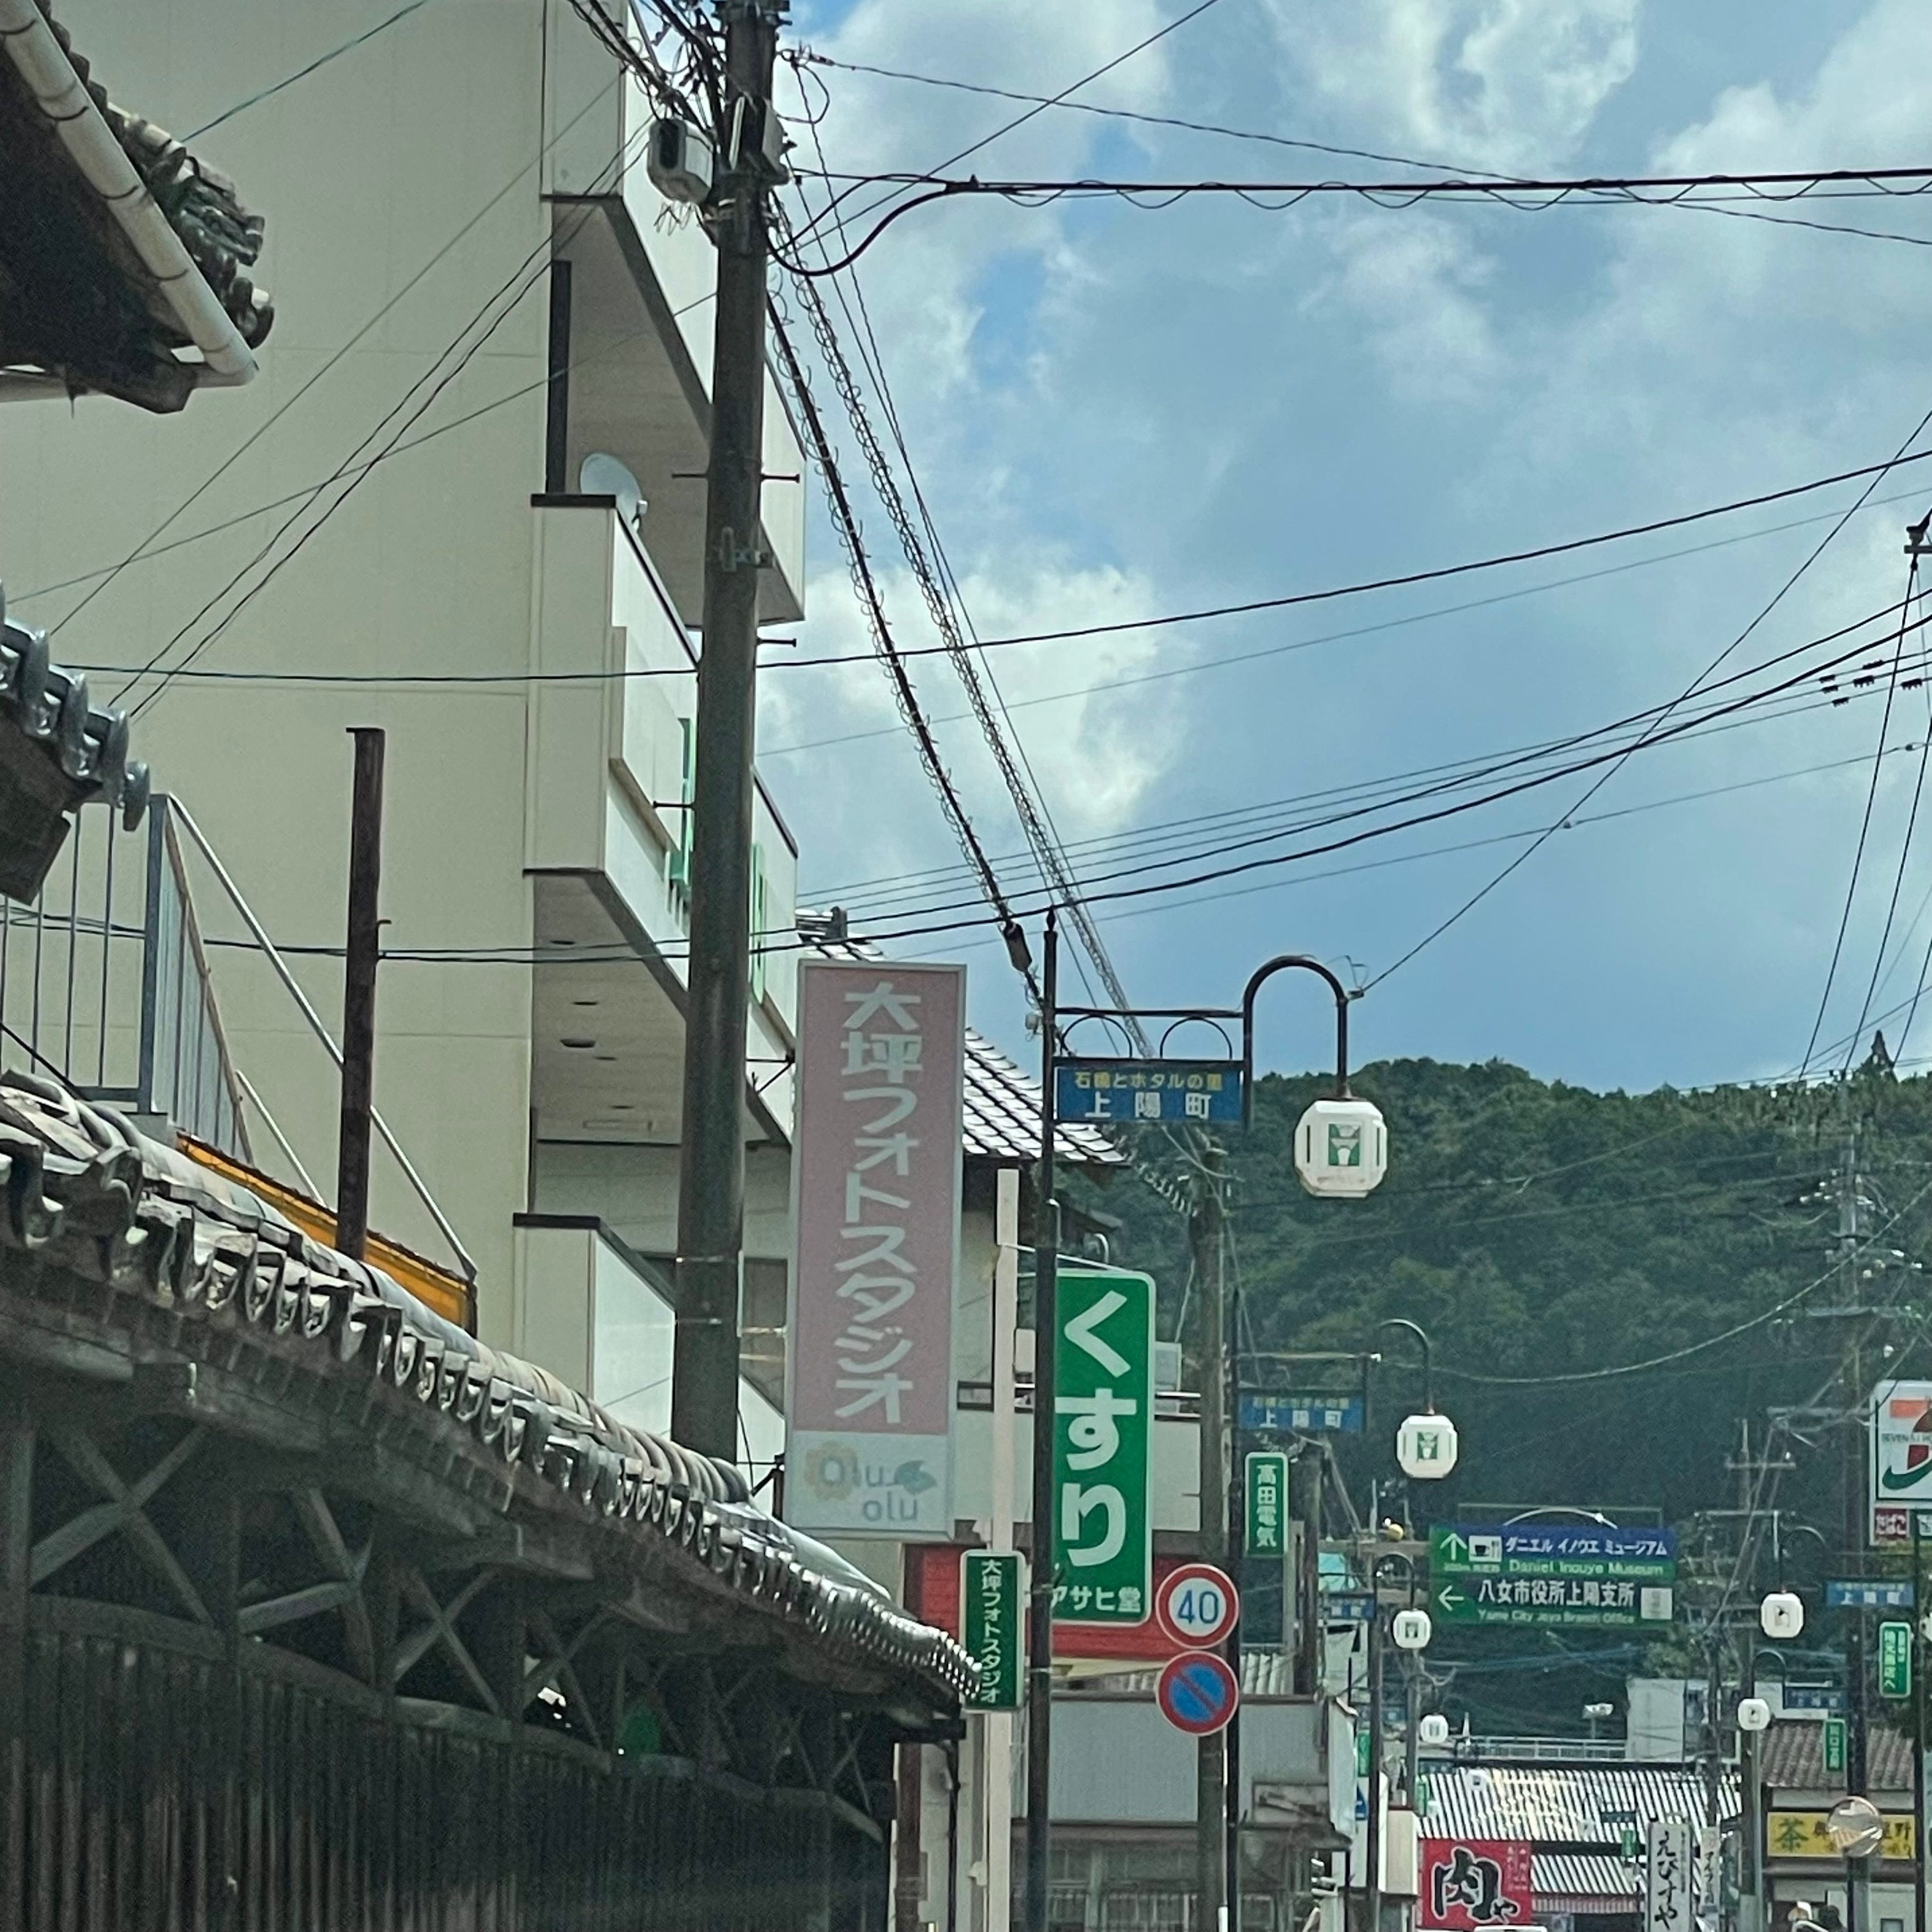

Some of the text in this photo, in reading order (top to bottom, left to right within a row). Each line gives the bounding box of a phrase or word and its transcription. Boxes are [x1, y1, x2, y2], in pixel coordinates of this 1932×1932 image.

[1085, 1091, 1211, 1118] 上陽町
[834, 981, 922, 1425] 大坪フォトスタジオ
[1055, 1290, 1137, 1567] くすり
[1505, 1537, 1667, 1556] ダニエル イノウエ ミュージアム
[1509, 1559, 1554, 1573] Daniel
[1608, 1562, 1664, 1575] Museum
[1177, 1589, 1219, 1625] 40
